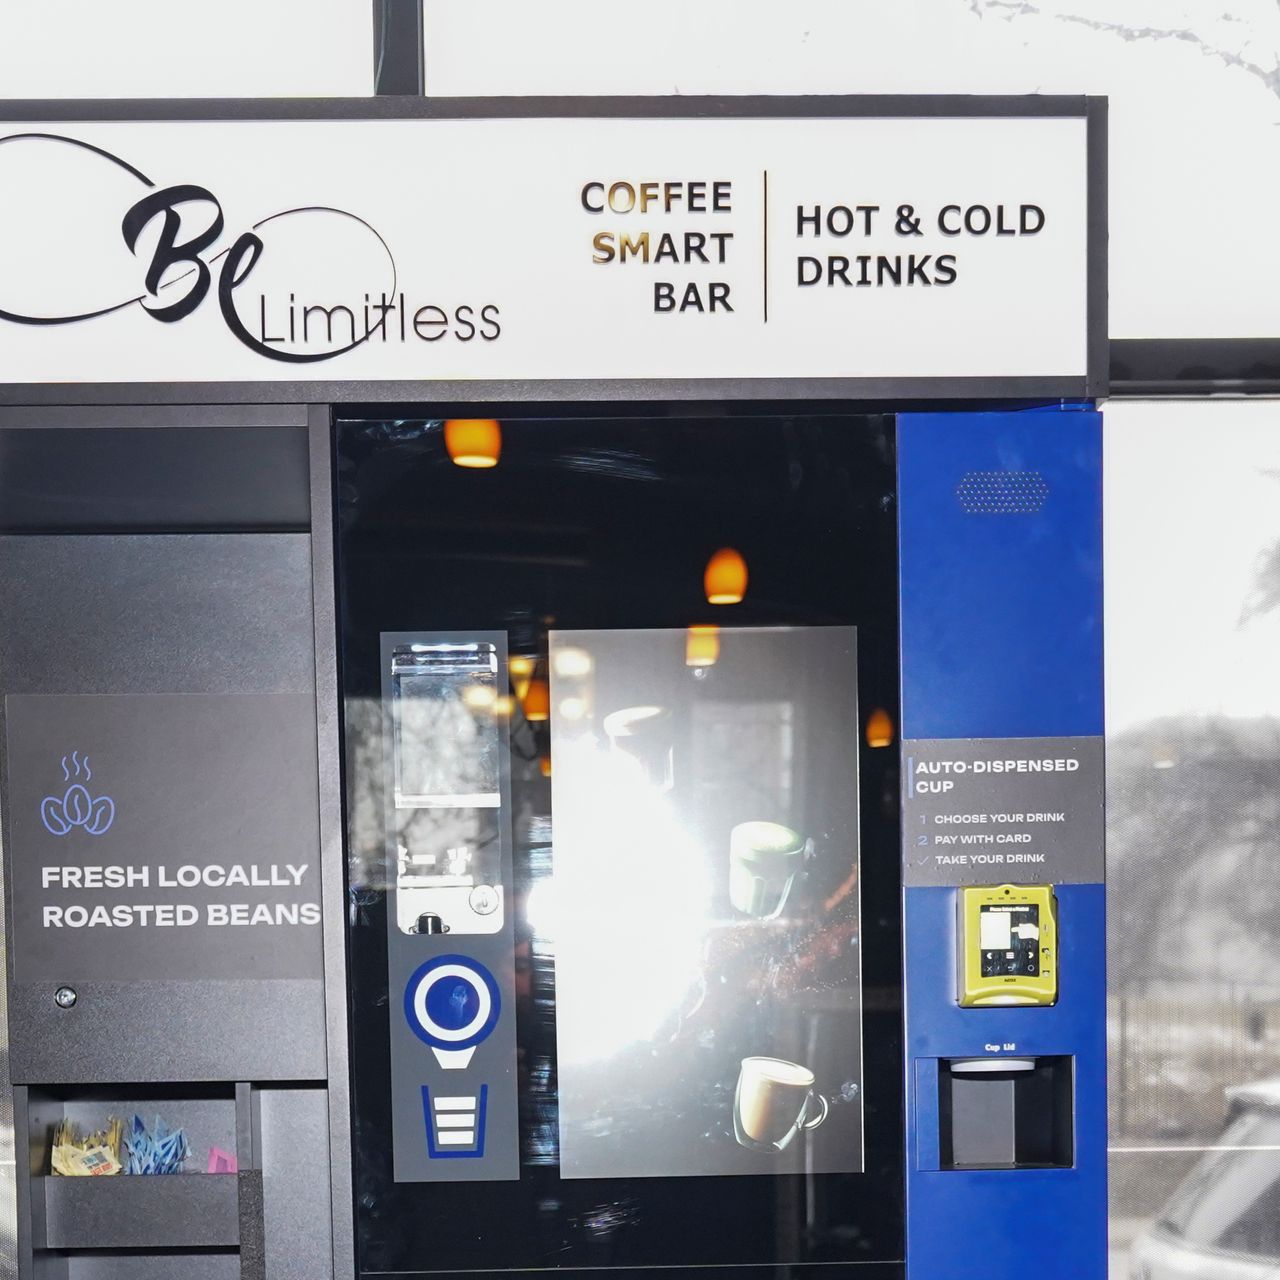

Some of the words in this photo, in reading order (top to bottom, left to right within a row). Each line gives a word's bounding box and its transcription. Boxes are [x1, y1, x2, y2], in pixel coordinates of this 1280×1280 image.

[580, 181, 732, 213] COFFEE
[796, 204, 880, 237] HOT
[894, 204, 923, 236] &
[937, 203, 1046, 236] COLD
[592, 231, 734, 264] SMART
[796, 254, 958, 286] DRINKS
[653, 281, 734, 313] BAR
[260, 292, 502, 344] Limitless
[915, 758, 1080, 775] AUTO-DISPENSED
[915, 780, 954, 794] CUP
[934, 814, 988, 825] CHOOSE
[990, 813, 1024, 824] YOUR
[1026, 812, 1065, 823] DRINK
[918, 835, 928, 846] 2
[934, 835, 959, 846] PAY
[960, 834, 994, 845] WITH
[996, 833, 1032, 844] CARD
[935, 855, 968, 865] TAKE
[970, 854, 1004, 865] YOUR
[1006, 853, 1046, 864] DRINK
[41, 866, 149, 889] FRESH
[158, 864, 309, 888] LOCALLY
[42, 905, 199, 928] ROASTED
[207, 903, 321, 926] BEANS
[984, 1043, 1001, 1052] Cup
[1003, 1043, 1016, 1051] Lid
